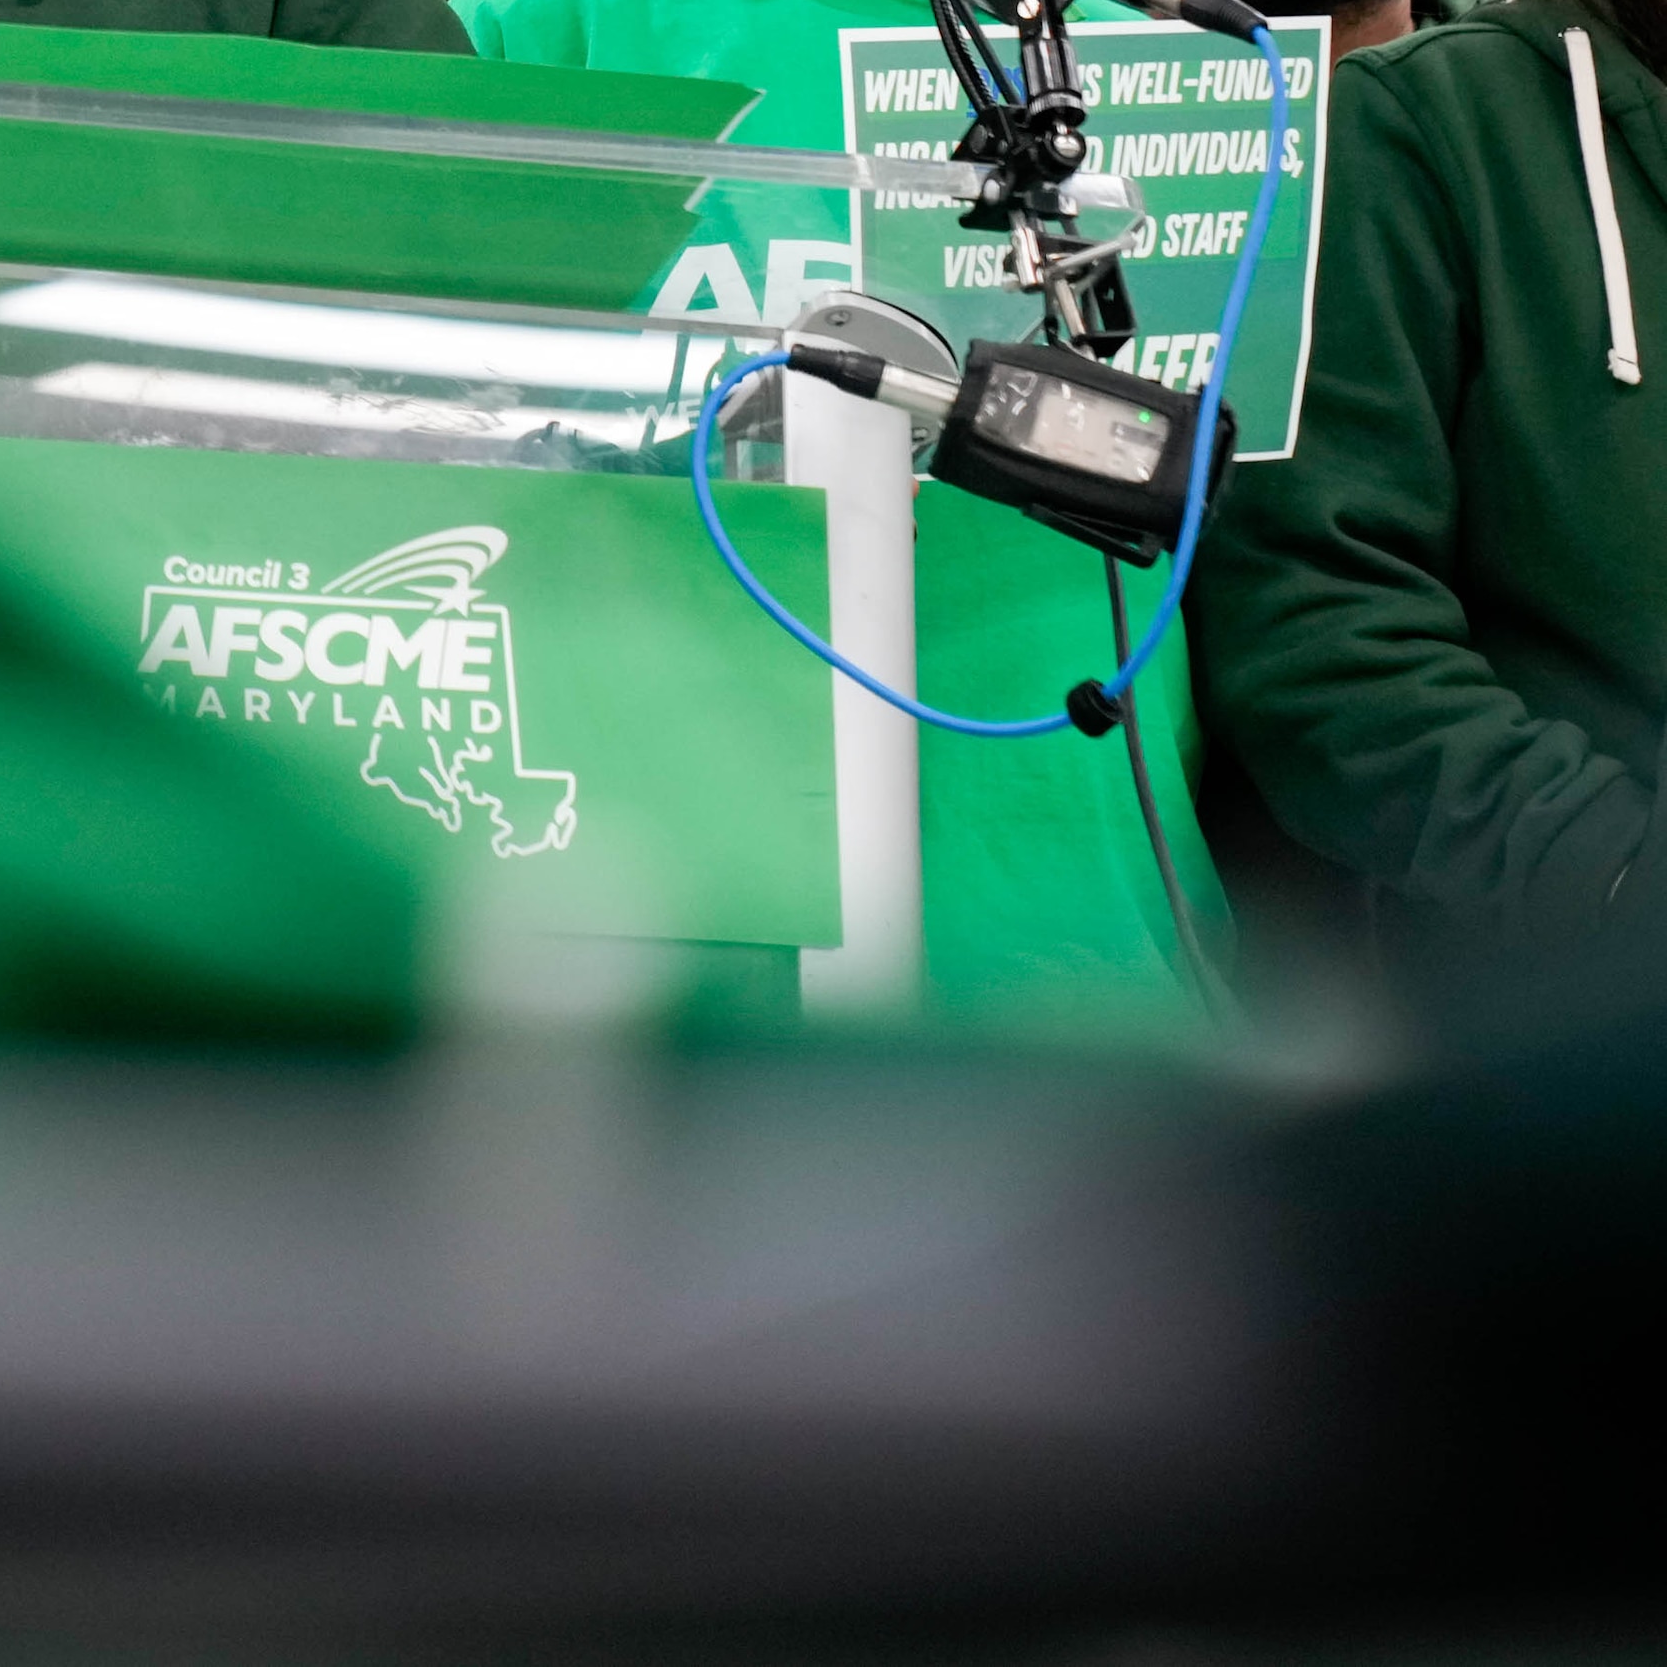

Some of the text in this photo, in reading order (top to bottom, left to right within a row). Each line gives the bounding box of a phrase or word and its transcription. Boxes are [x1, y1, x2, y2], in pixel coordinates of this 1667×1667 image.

[864, 68, 960, 113] WHEN
[1111, 128, 1304, 179] INDIVIDUAS,
[1161, 211, 1248, 258] STAFF
[163, 555, 311, 591] Council 3
[137, 604, 497, 692] AFSCME
